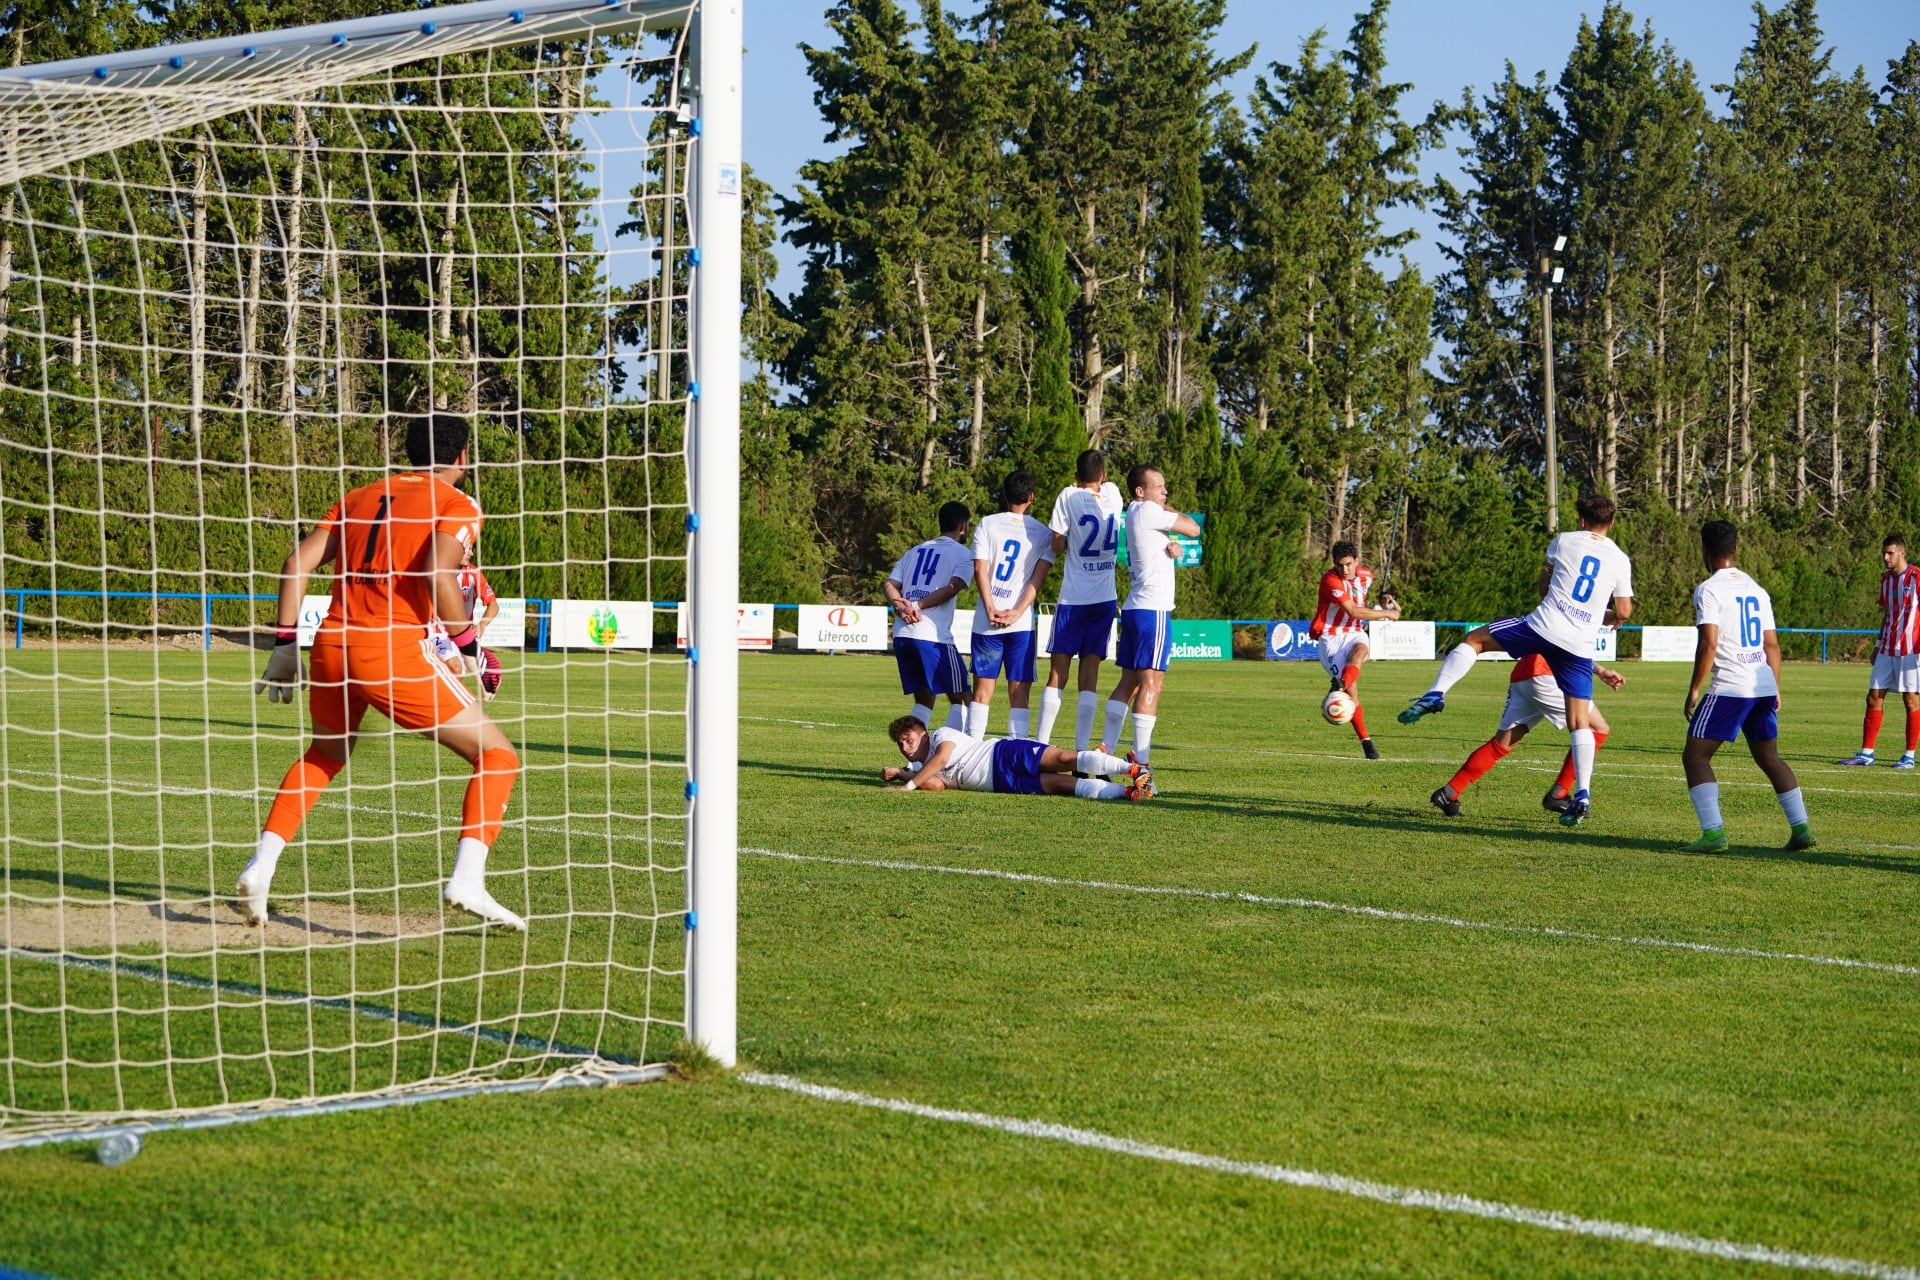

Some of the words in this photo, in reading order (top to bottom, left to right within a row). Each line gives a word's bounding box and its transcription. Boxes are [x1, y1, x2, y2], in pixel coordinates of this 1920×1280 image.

[363, 495, 395, 564] 1
[1078, 513, 1119, 558] 24
[911, 548, 941, 586] 14
[995, 539, 1021, 581] 3
[1572, 555, 1601, 603] 8
[818, 630, 868, 643] Literosca
[1735, 596, 1761, 648] 16
